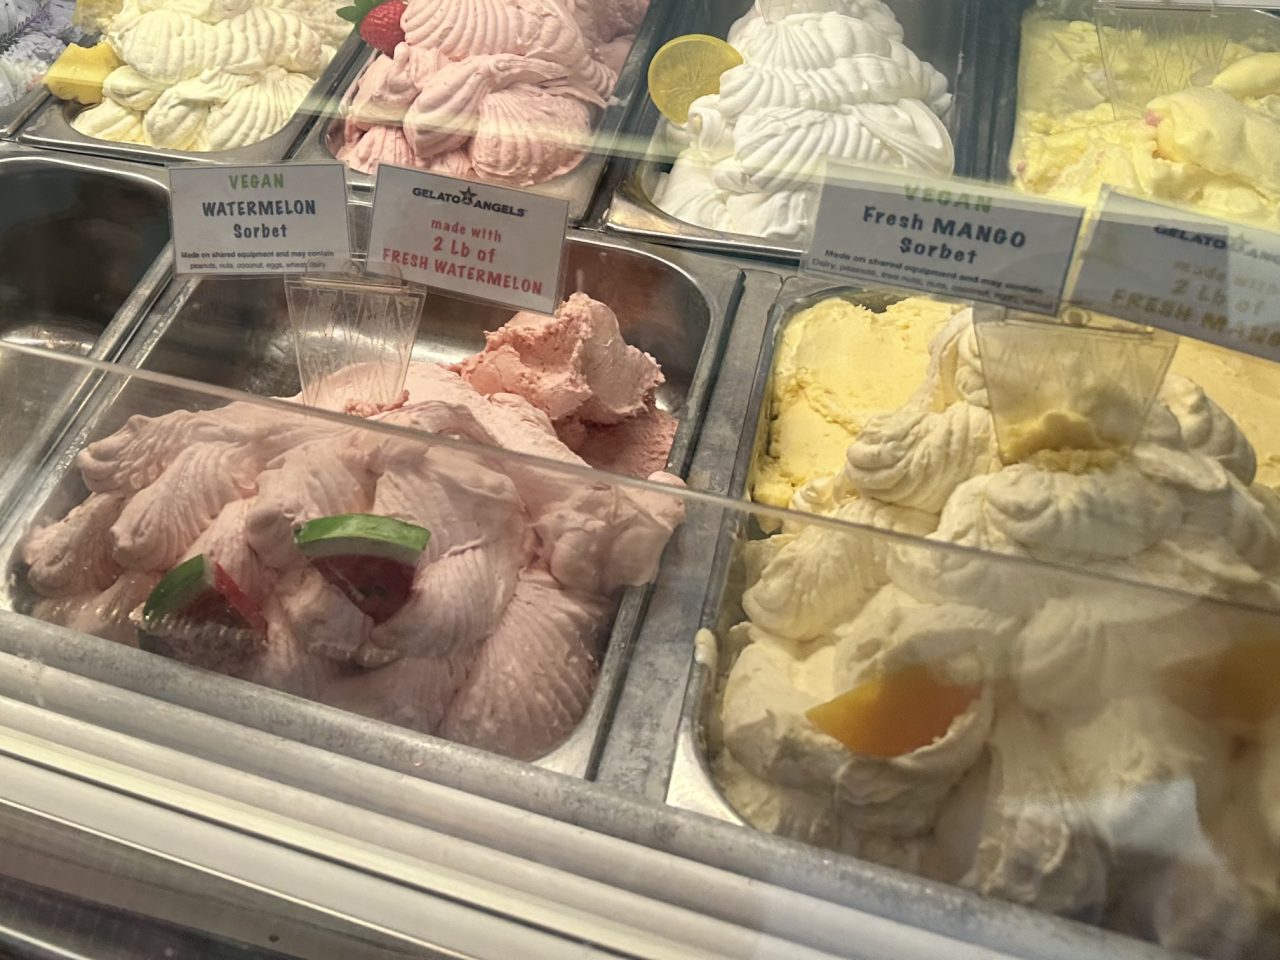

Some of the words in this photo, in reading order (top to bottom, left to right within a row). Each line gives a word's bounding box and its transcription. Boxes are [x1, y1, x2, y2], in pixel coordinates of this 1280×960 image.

[229, 173, 284, 190] VEGAN
[202, 200, 316, 217] WATERMELON
[412, 187, 461, 205] GELATO
[474, 200, 526, 217] ANGELS
[904, 184, 993, 214] VEGAN
[233, 223, 287, 239] Sorbet
[431, 218, 466, 236] made
[470, 226, 502, 242] with
[862, 205, 924, 232] Fresh
[931, 217, 1026, 249] MANGO
[1153, 224, 1228, 250] GELATO
[432, 236, 443, 252] 2
[450, 240, 470, 258] Lb
[477, 247, 496, 264] of
[900, 237, 977, 265] Sorbet
[382, 248, 428, 271] FRESH
[434, 259, 543, 295] WATERMELON
[1112, 287, 1192, 321] FRESH
